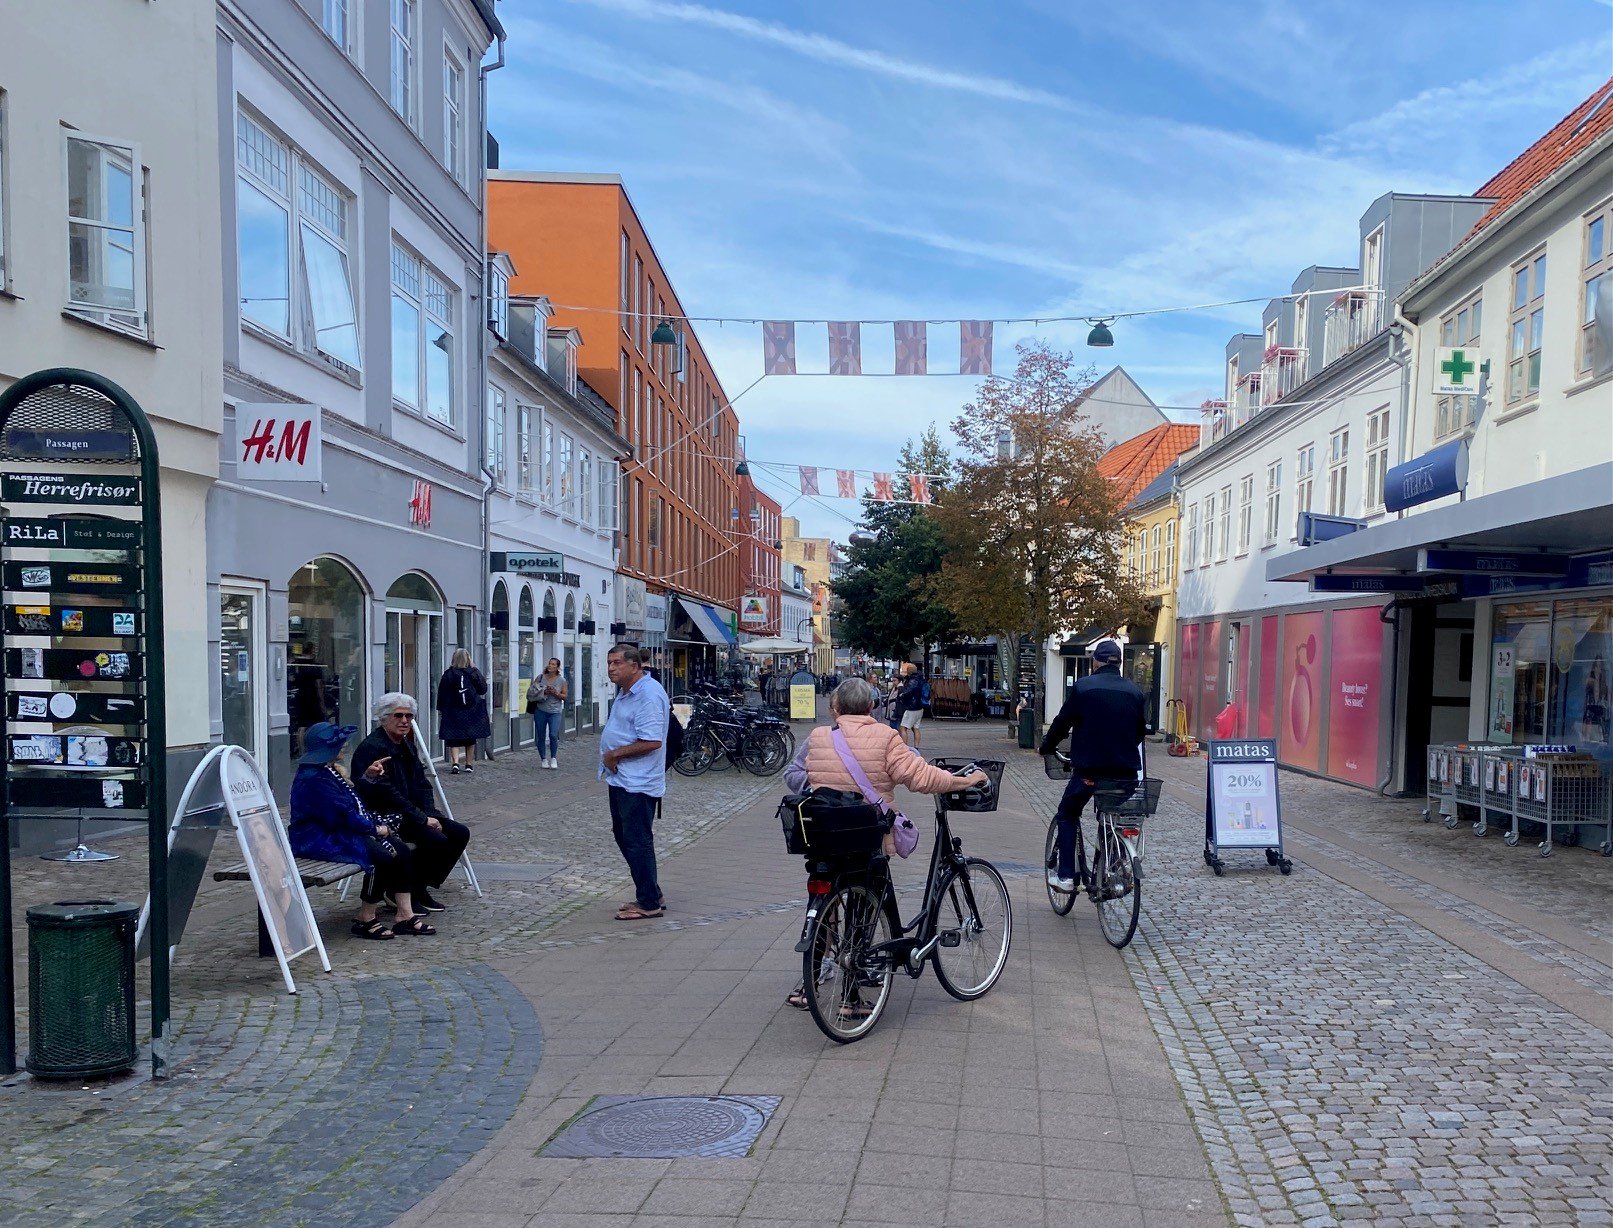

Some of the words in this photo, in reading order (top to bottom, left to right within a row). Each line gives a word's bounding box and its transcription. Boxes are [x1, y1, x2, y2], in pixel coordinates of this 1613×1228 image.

[46, 438, 88, 450] Passagen
[242, 419, 312, 465] H&M
[23, 481, 135, 500] Herrefrisør
[9, 525, 59, 540] RiLa
[509, 557, 559, 569] apotek
[1216, 744, 1269, 757] matas
[229, 780, 257, 794] ANDORA
[1227, 774, 1262, 788] 20%
